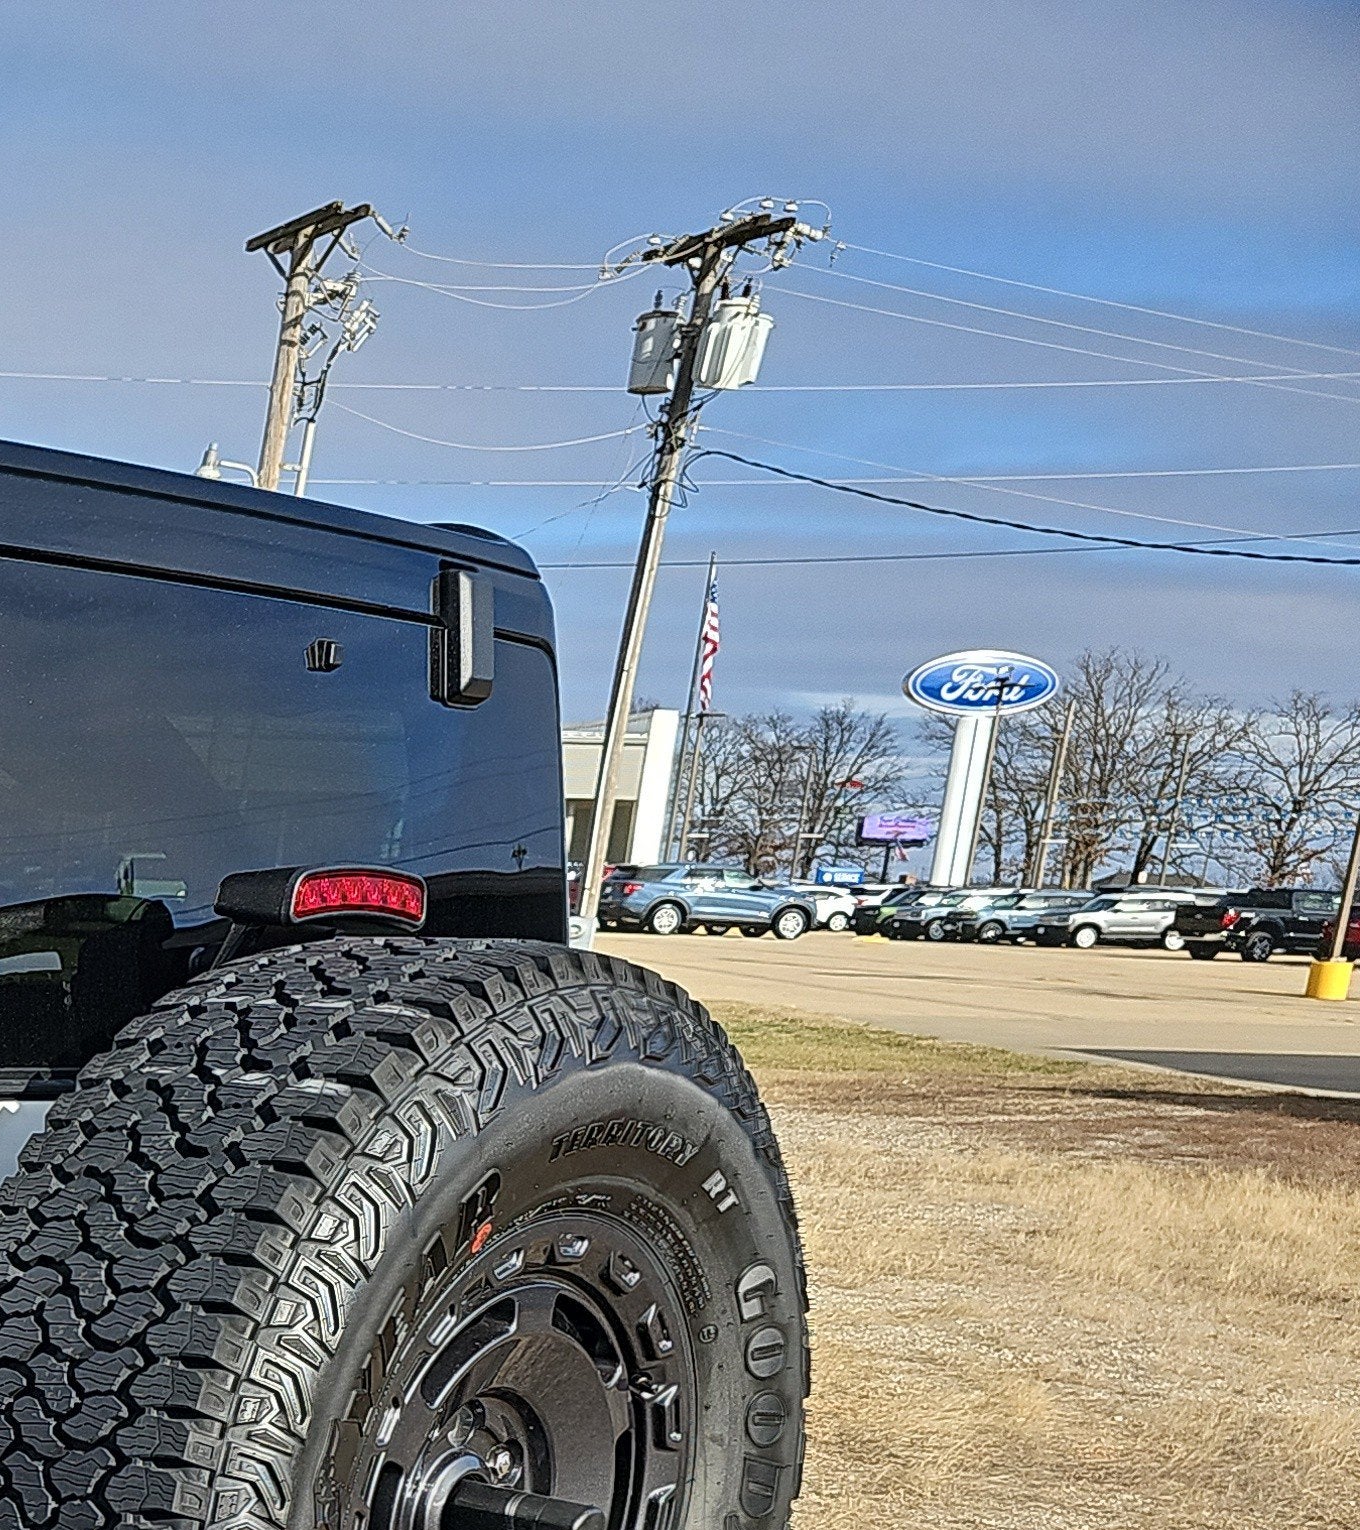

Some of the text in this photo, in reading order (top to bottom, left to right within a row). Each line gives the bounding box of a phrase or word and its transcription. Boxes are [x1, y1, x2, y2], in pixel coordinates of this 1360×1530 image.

[940, 663, 1031, 702] Ford
[548, 1117, 740, 1214] TERRITORY RT
